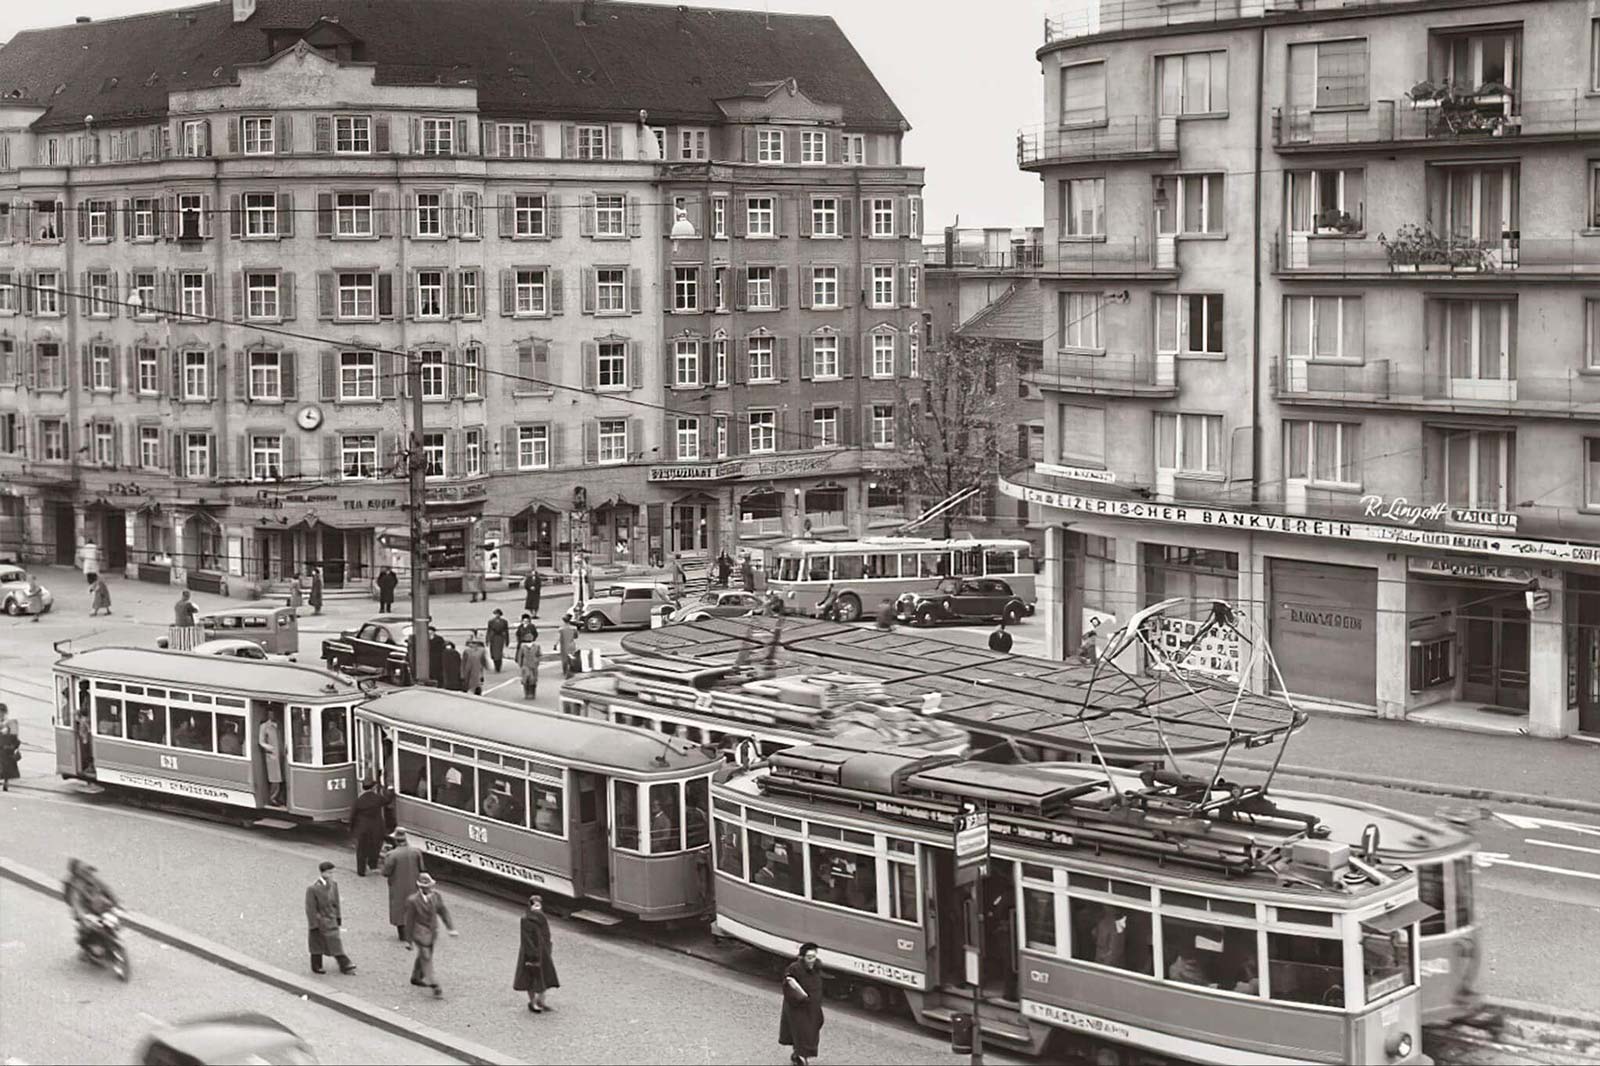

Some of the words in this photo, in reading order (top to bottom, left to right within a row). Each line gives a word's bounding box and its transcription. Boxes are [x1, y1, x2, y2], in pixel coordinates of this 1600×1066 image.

[1202, 511, 1351, 536] BANKVEREIN
[1455, 510, 1518, 527] TAILLEUR
[1365, 826, 1376, 854] 1
[1030, 1004, 1129, 1037] STRASSENBAHN
